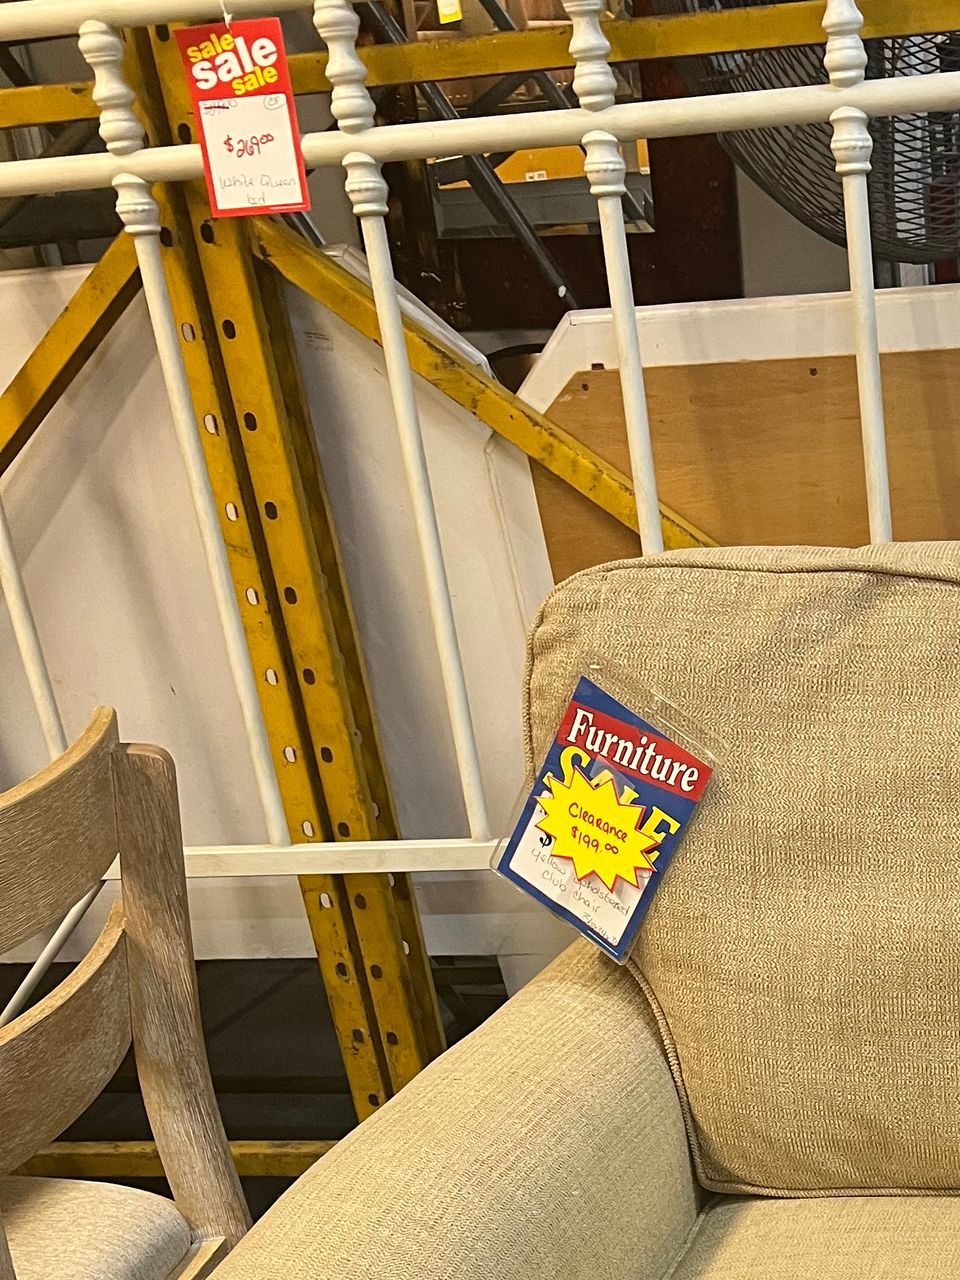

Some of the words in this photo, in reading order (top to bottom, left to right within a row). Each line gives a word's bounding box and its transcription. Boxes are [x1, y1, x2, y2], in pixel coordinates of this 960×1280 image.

[187, 33, 234, 63] sale
[192, 37, 278, 90] sale
[232, 66, 278, 95] sale
[566, 707, 700, 793] Furniture
[543, 746, 681, 864] SE
[568, 802, 629, 843] Clearance
[571, 826, 619, 855] $199.00
